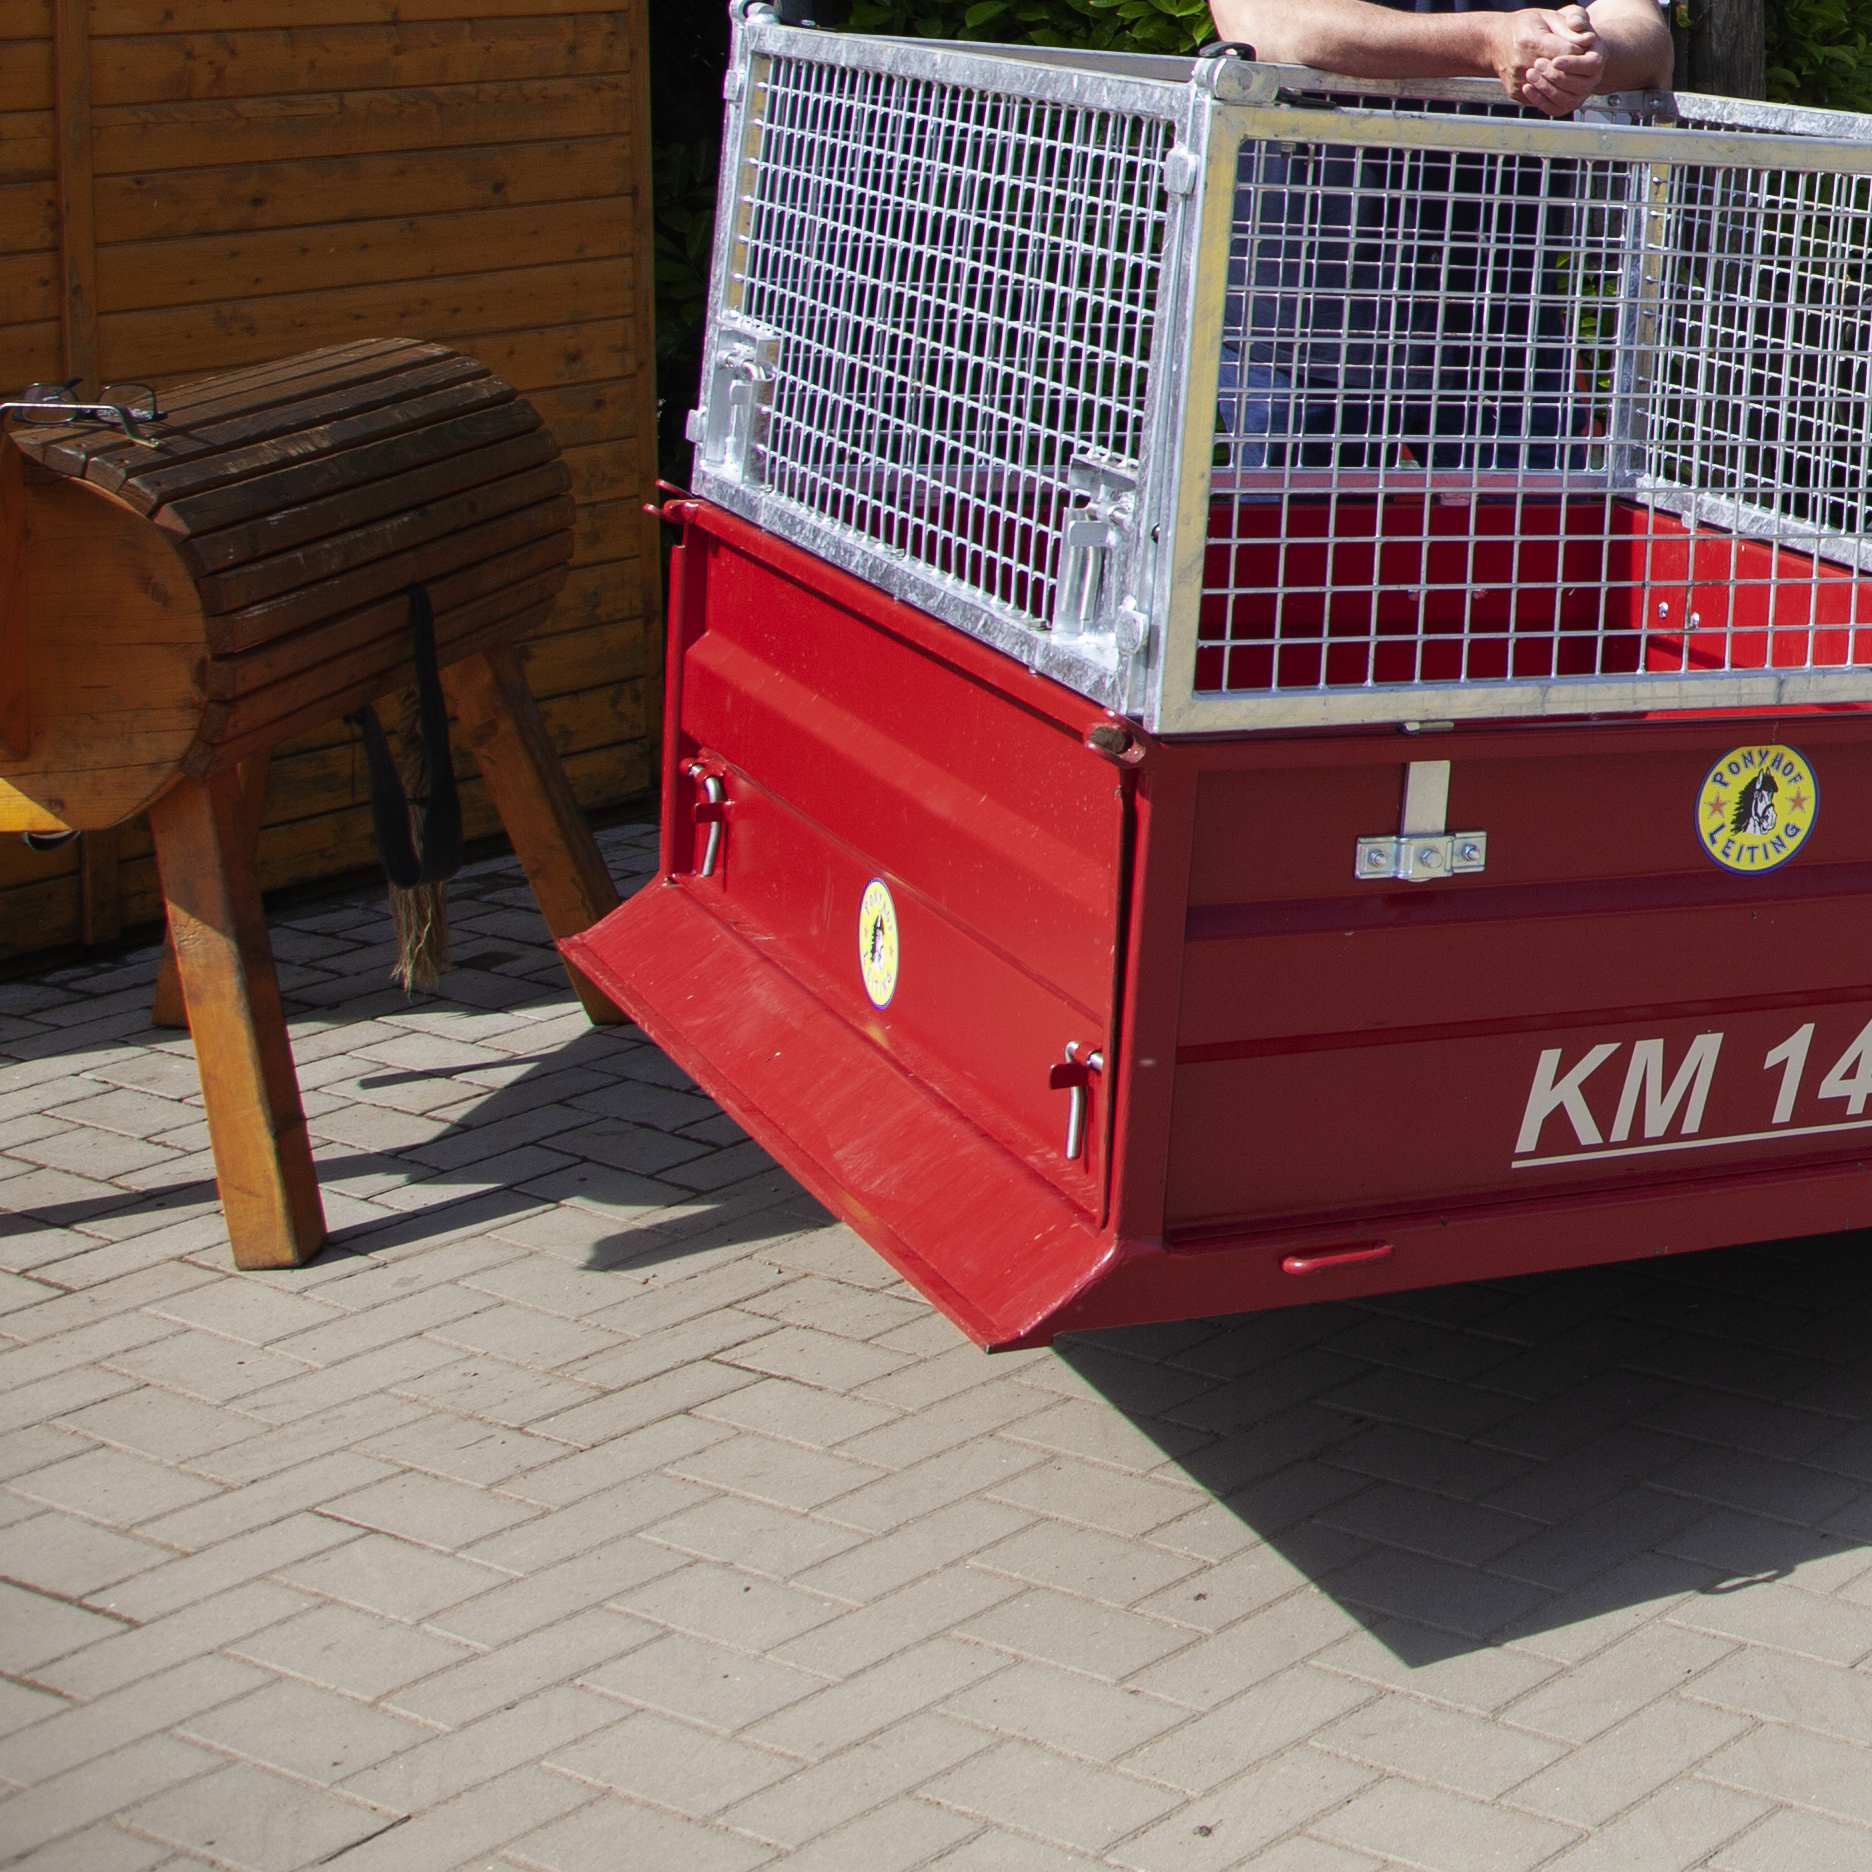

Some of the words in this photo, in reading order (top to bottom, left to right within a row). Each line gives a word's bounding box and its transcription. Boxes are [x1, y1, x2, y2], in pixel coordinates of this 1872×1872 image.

[1711, 748, 1804, 789] PONYHOF
[1708, 822, 1802, 864] LEITING
[1513, 1032, 1725, 1154] KM
